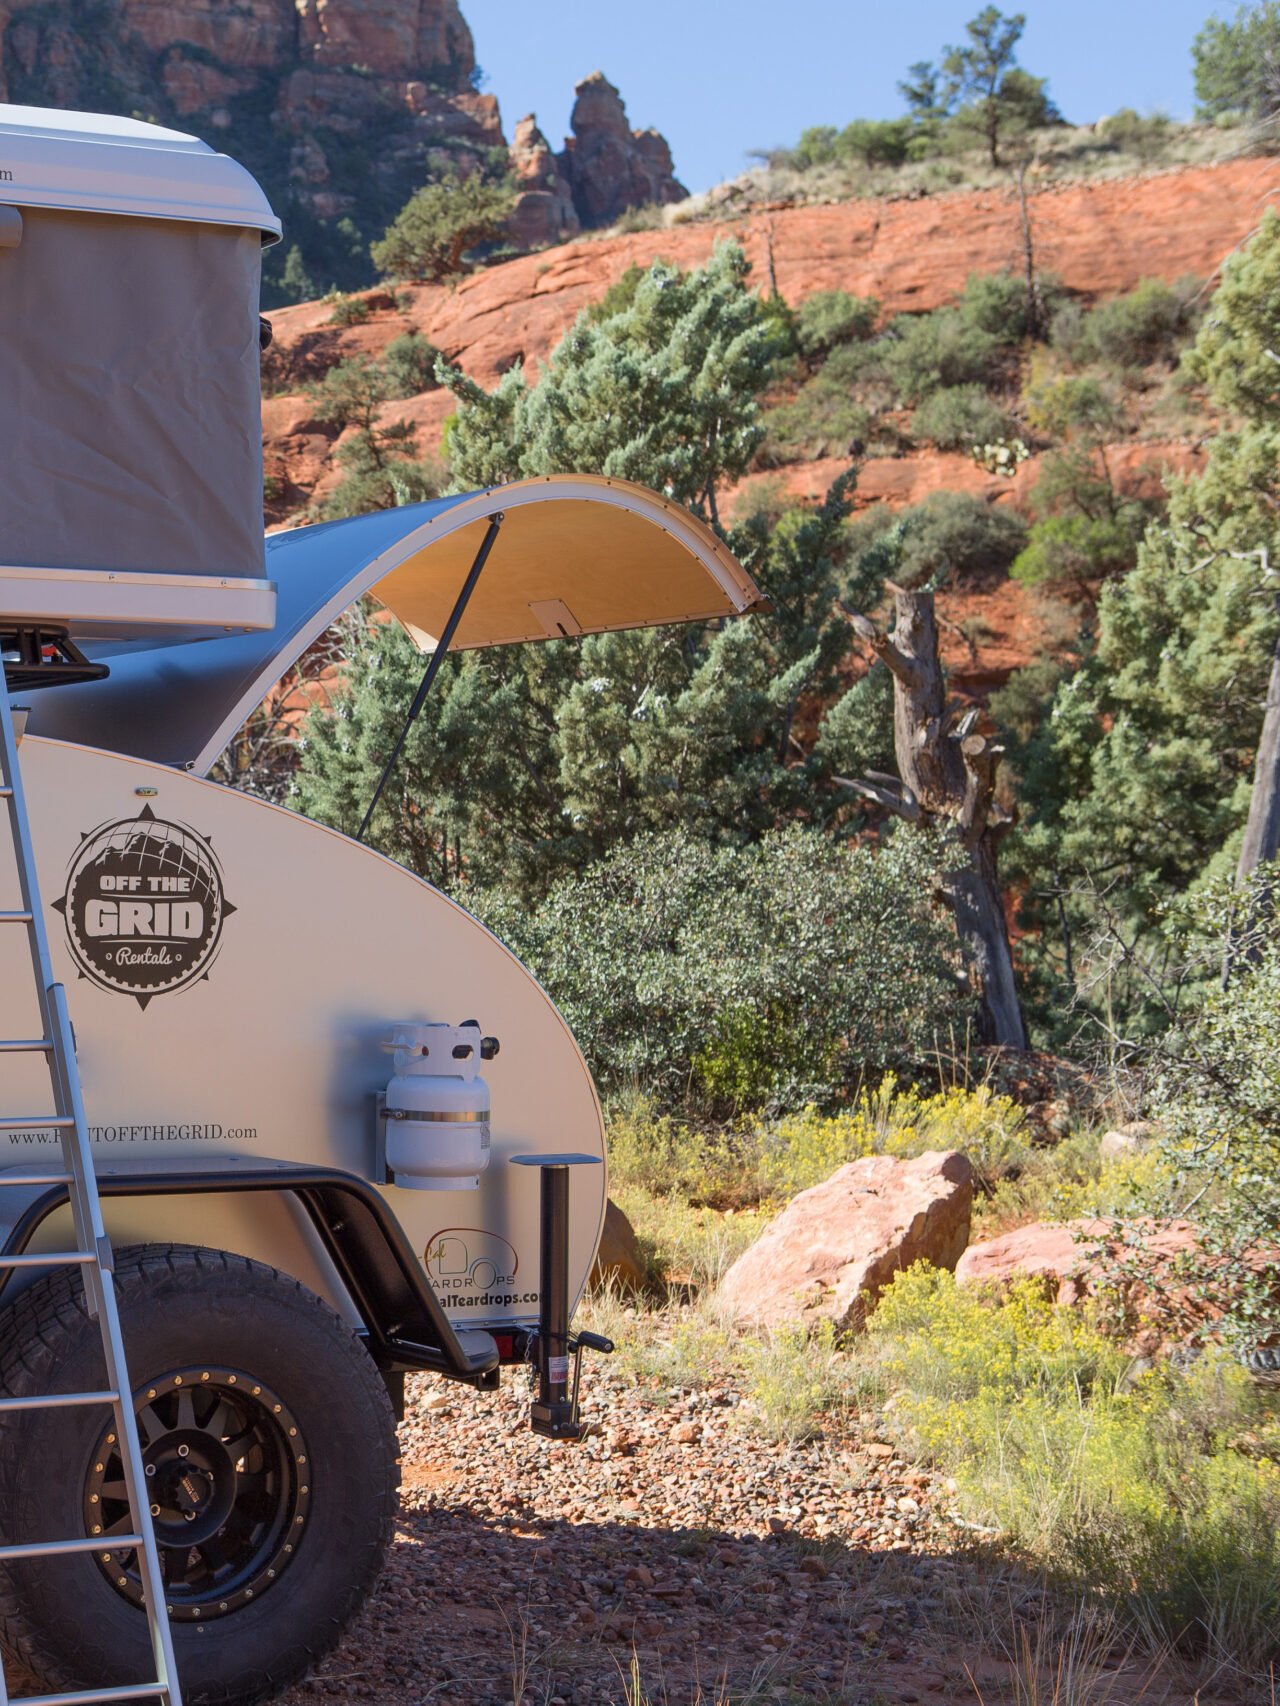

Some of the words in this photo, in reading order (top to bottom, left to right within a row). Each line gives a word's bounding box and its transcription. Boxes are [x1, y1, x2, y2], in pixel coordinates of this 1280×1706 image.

[100, 875, 142, 891] OFF
[147, 876, 191, 892] THE
[84, 899, 204, 938] GRID
[115, 946, 173, 966] Rentals
[8, 1124, 258, 1144] www.TOFFTHEGRID.com
[429, 1261, 516, 1289] ARDROPS
[439, 1292, 542, 1308] alTeardrops.co
